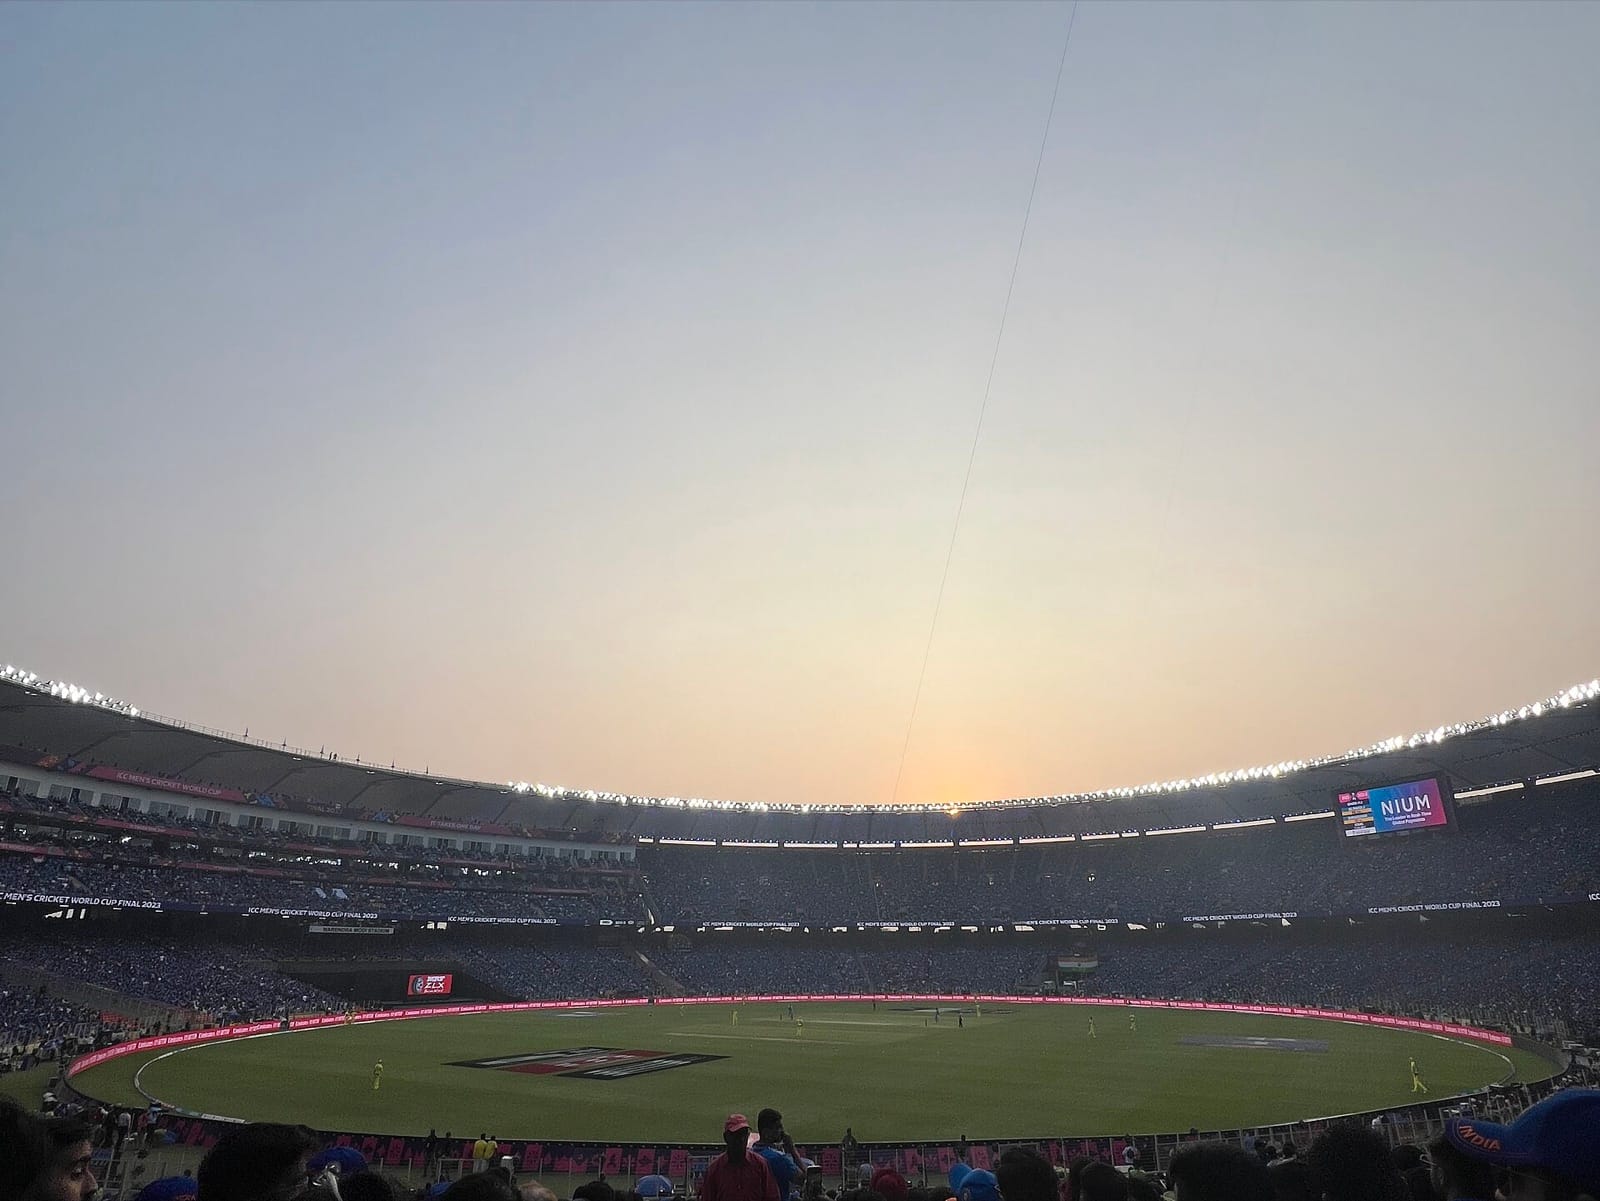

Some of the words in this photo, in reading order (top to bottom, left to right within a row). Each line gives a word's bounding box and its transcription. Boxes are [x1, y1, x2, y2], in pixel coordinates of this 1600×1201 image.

[1381, 794, 1430, 815] NIUM
[3, 892, 33, 902] MEN'S
[33, 894, 70, 904] CRICKET
[71, 896, 100, 905] WORLD
[101, 898, 117, 906] CUP
[117, 899, 141, 908] FINAL
[142, 901, 162, 909] 2023
[1398, 904, 1423, 912] CRICKET
[1424, 903, 1447, 911] WORLD
[1462, 901, 1482, 909] FINAL
[1482, 900, 1500, 908] 2023
[260, 907, 280, 915] MEN'S
[280, 908, 308, 916] CRICKET
[344, 911, 361, 919] FINAL
[1459, 1125, 1501, 1151] INDIA
